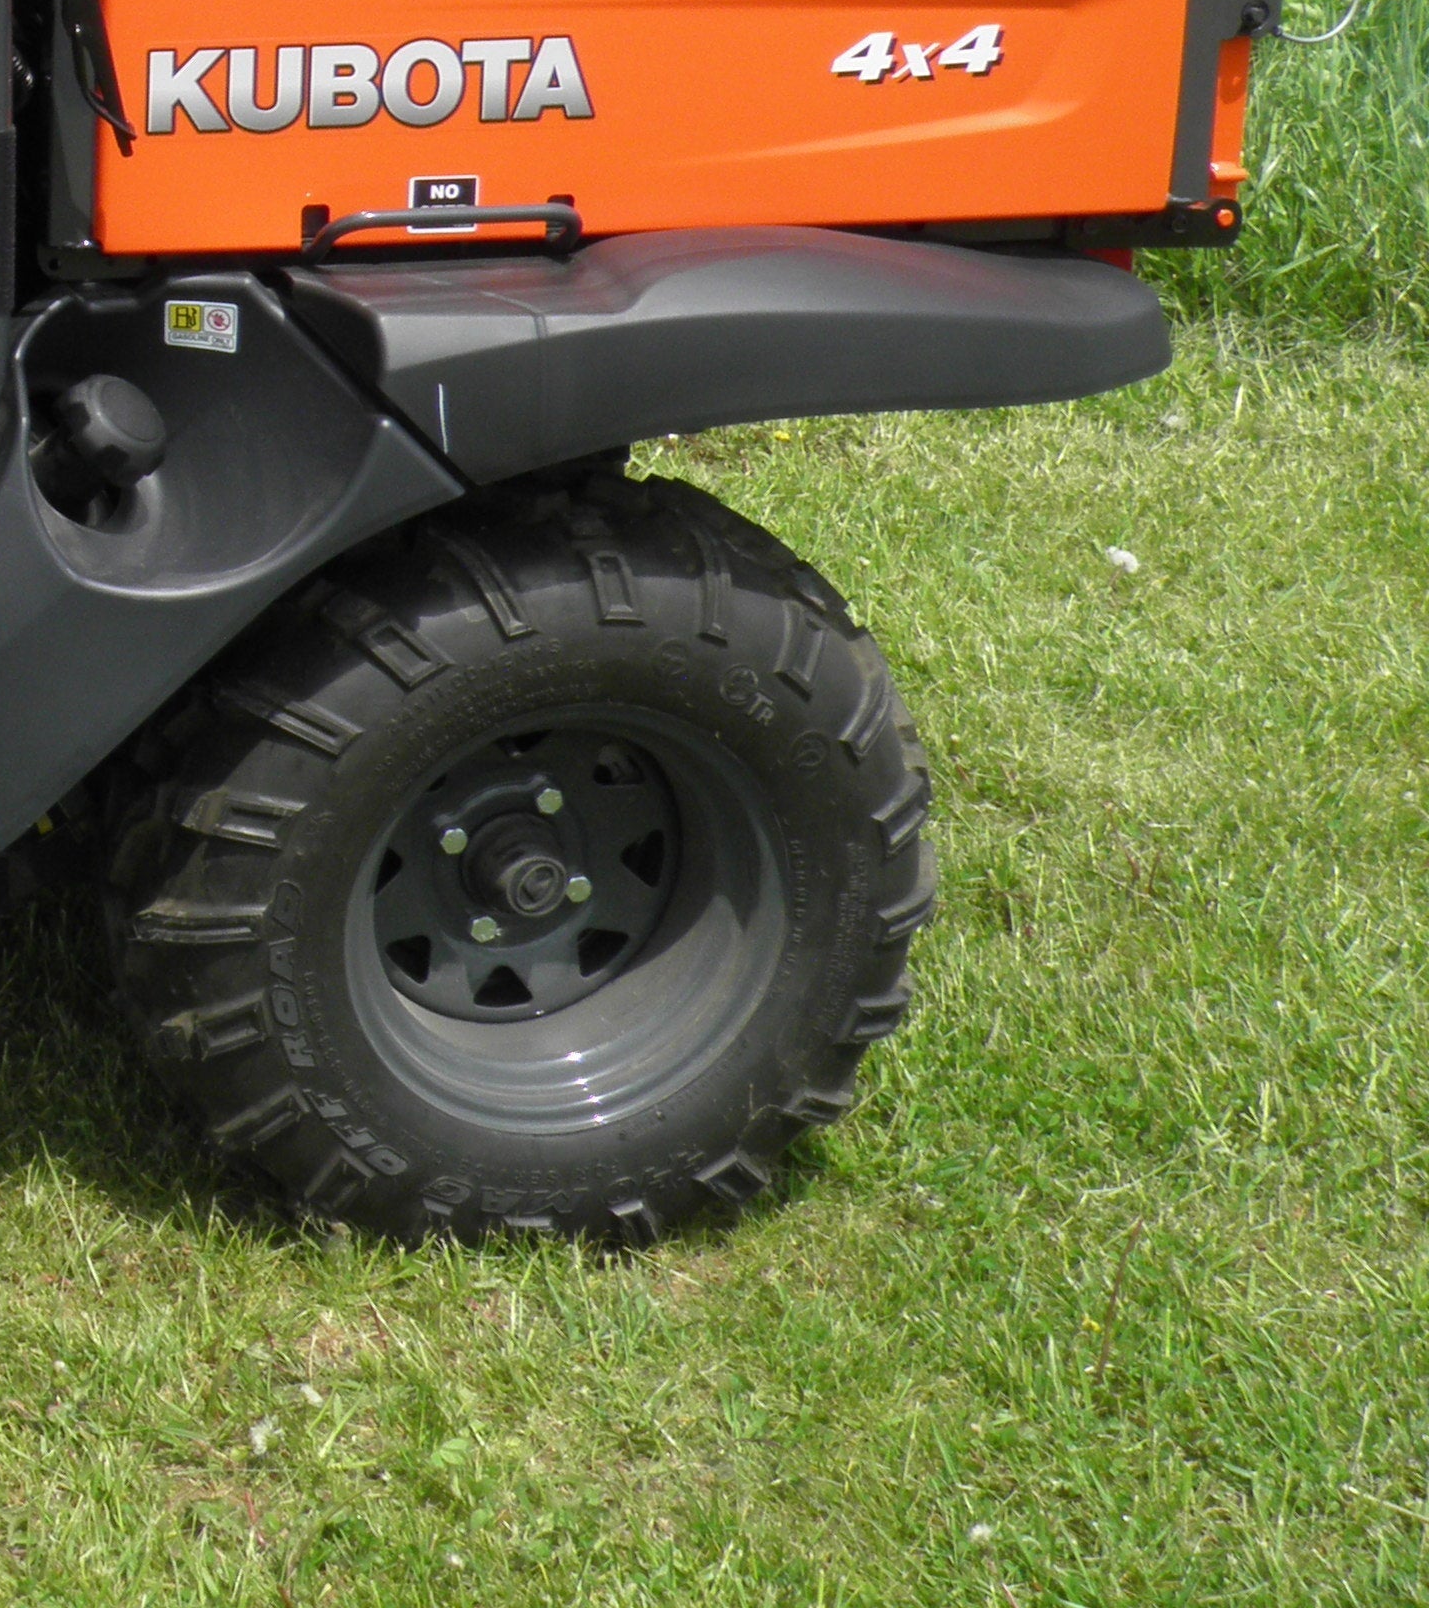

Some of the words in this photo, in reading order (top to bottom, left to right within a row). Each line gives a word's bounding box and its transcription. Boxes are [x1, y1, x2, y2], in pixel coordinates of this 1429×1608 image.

[146, 35, 595, 135] KUBOTA
[830, 23, 1005, 85] 4x4
[430, 183, 460, 200] NO
[267, 879, 317, 1068] ROAD
[303, 1089, 409, 1176] OFF
